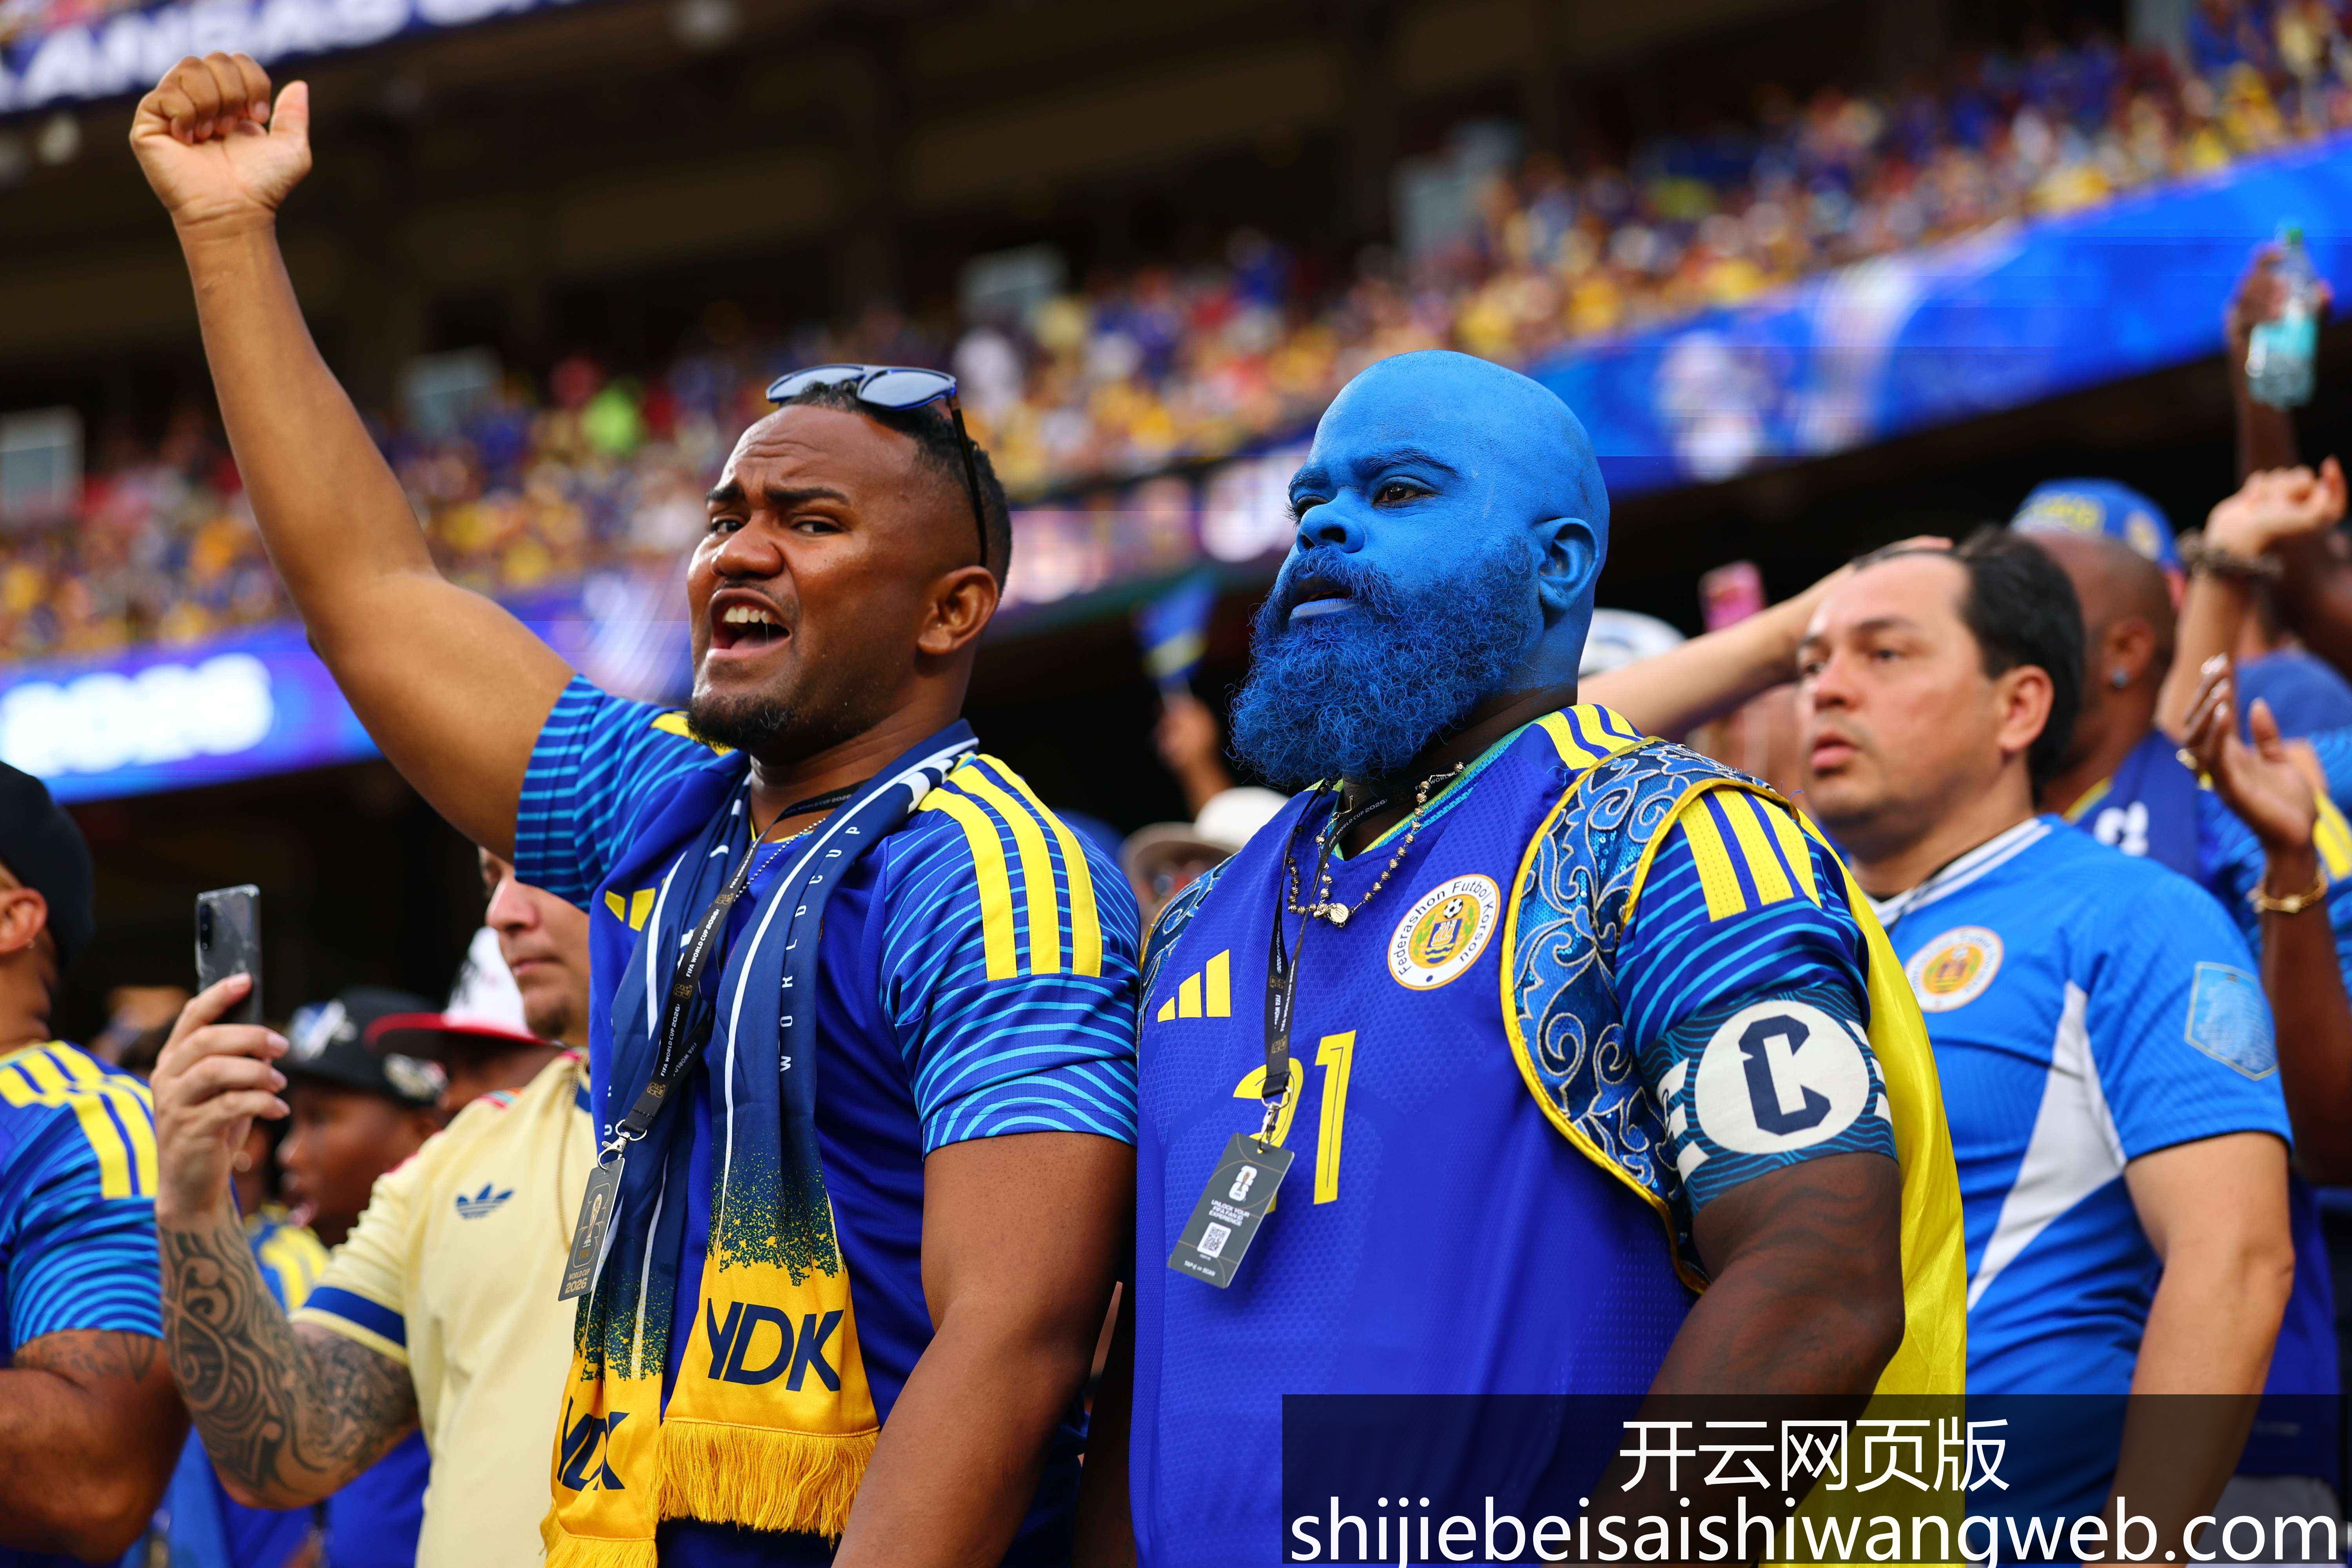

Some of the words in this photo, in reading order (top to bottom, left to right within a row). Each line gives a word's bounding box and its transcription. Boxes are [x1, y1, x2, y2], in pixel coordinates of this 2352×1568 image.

[1337, 819, 1352, 835] WORLD
[1353, 811, 1364, 820] CUP
[1365, 799, 1387, 813] 2026
[686, 964, 695, 977] FIFA
[691, 941, 703, 963] WORLD
[700, 929, 708, 941] CUP
[706, 909, 719, 930] 2026
[780, 904, 807, 1072] WORLD
[808, 826, 861, 885] CUP
[1394, 890, 1445, 975] Federashon
[1738, 1014, 1831, 1136] C
[1211, 1199, 1234, 1211] UNLOCK
[564, 1277, 588, 1294] 2026
[568, 1270, 583, 1280] WORLD
[581, 1268, 590, 1277] CUP
[707, 1298, 844, 1391] YDK
